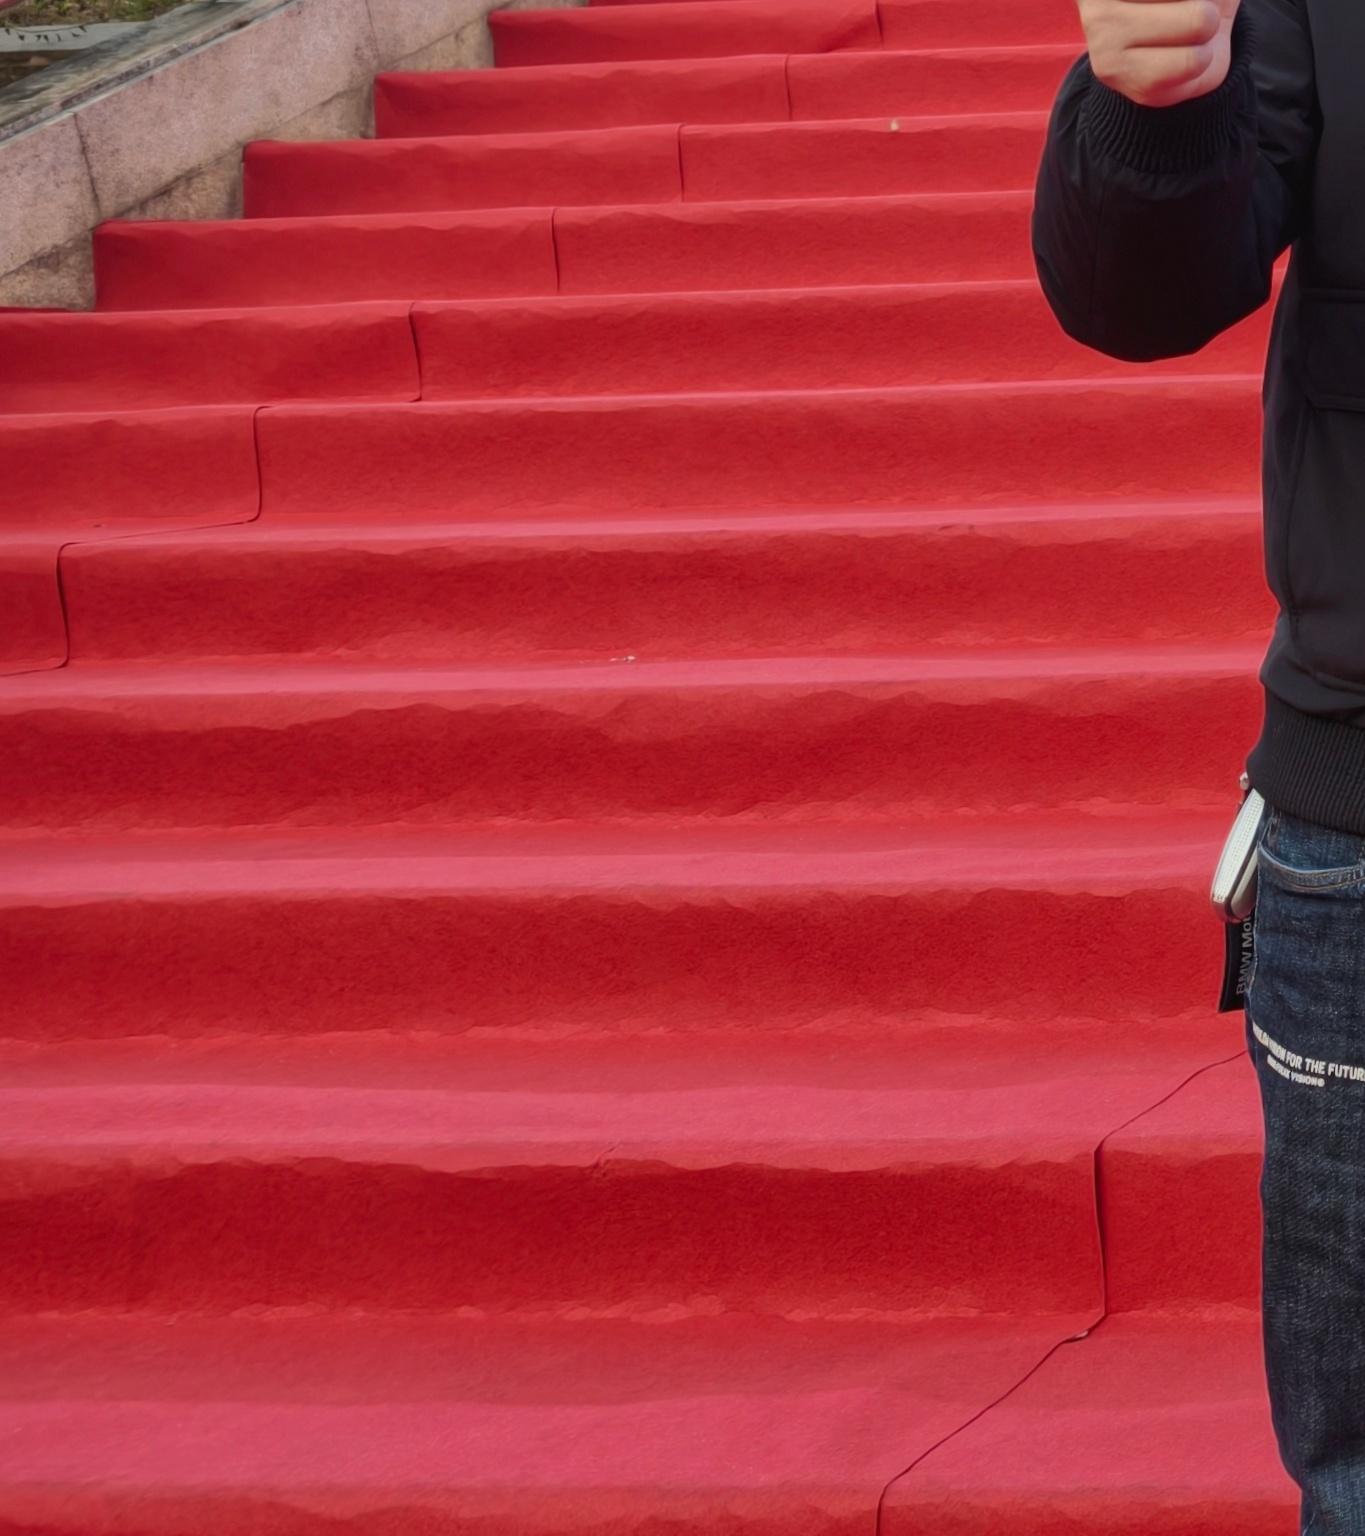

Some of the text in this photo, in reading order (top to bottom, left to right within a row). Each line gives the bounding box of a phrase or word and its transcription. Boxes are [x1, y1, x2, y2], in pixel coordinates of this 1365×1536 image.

[1235, 951, 1252, 995] BMW
[1285, 1050, 1302, 1070] FOR
[1305, 1057, 1326, 1075] THE
